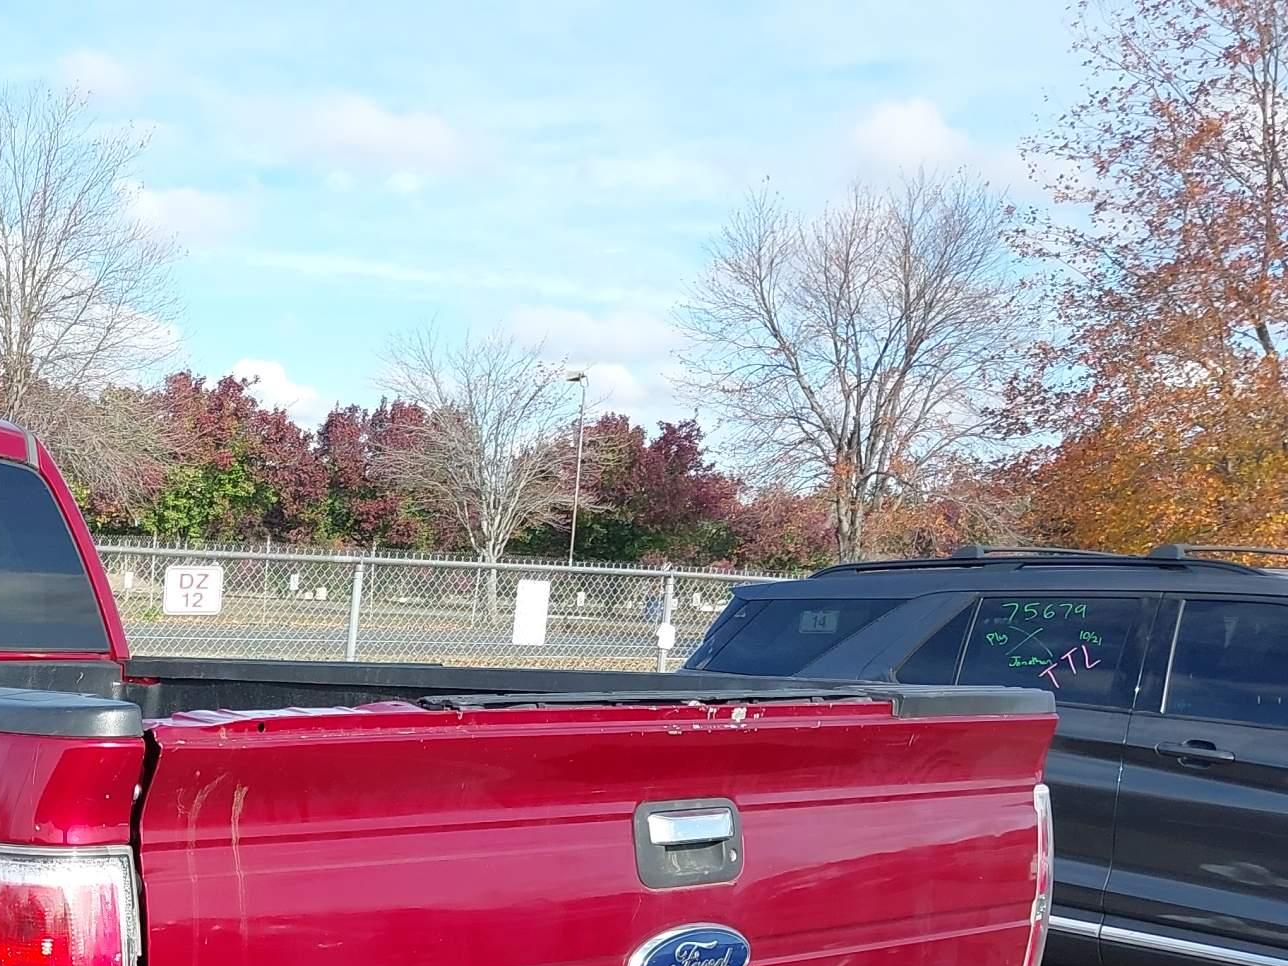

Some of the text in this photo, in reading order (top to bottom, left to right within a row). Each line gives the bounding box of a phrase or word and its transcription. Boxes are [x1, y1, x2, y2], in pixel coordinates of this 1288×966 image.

[179, 573, 210, 590] DZ
[182, 592, 204, 608] 12
[1001, 602, 1088, 623] 75679
[1038, 644, 1102, 689] TTL
